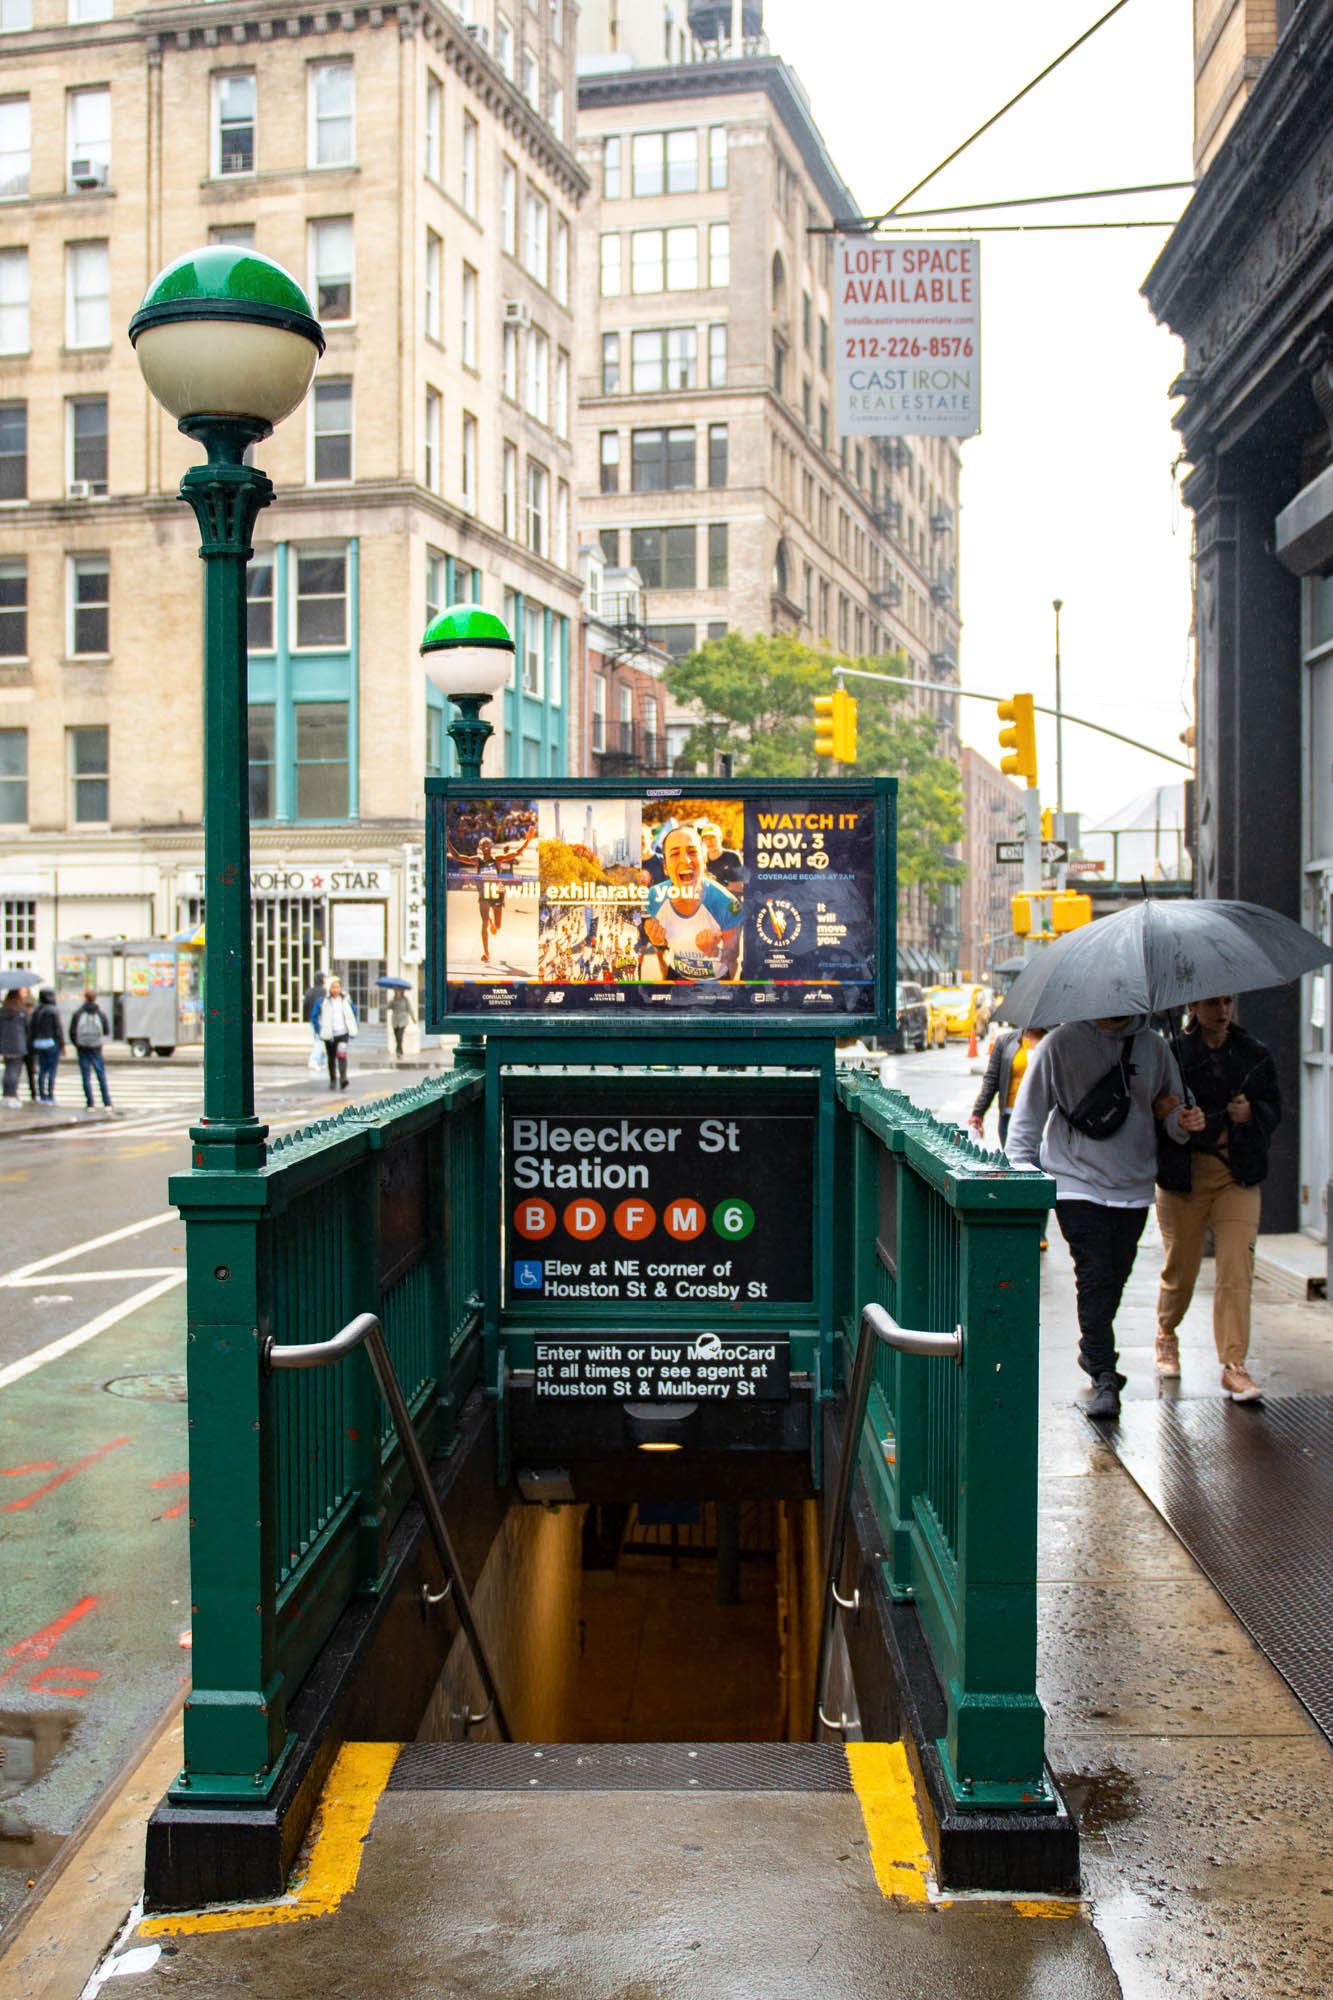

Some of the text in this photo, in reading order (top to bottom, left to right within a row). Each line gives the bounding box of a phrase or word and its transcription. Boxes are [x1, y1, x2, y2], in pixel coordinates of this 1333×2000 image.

[844, 248, 973, 275] LOFT SPACE
[843, 278, 974, 305] AVAILABLE
[846, 337, 974, 359] 212-226-8576
[849, 369, 970, 391] CAST IRON
[849, 394, 970, 410] REAL ESTATE
[757, 813, 859, 831] WATCH IT
[757, 832, 825, 850] NOV. 3
[756, 851, 802, 869] 9AM
[330, 871, 380, 890] STAR
[757, 873, 798, 881] COVERAGE
[483, 881, 700, 901] It will exhilarate you.
[816, 902, 827, 913] It
[816, 912, 837, 923] will
[816, 924, 848, 933] move
[816, 936, 841, 947] you.
[513, 1119, 741, 1153] Bleecker St
[513, 1155, 650, 1190] Station
[525, 1206, 744, 1232] B D F M 6
[544, 1260, 733, 1278] Elev at NE corner of
[544, 1280, 768, 1300] Houston St & Crosby St
[537, 1346, 582, 1361] Enter
[587, 1346, 622, 1361] with
[627, 1348, 646, 1361] or
[651, 1346, 682, 1364] buy
[537, 1363, 768, 1382] at all times or see agent at
[537, 1380, 756, 1399] Houston St & Mulberry St
